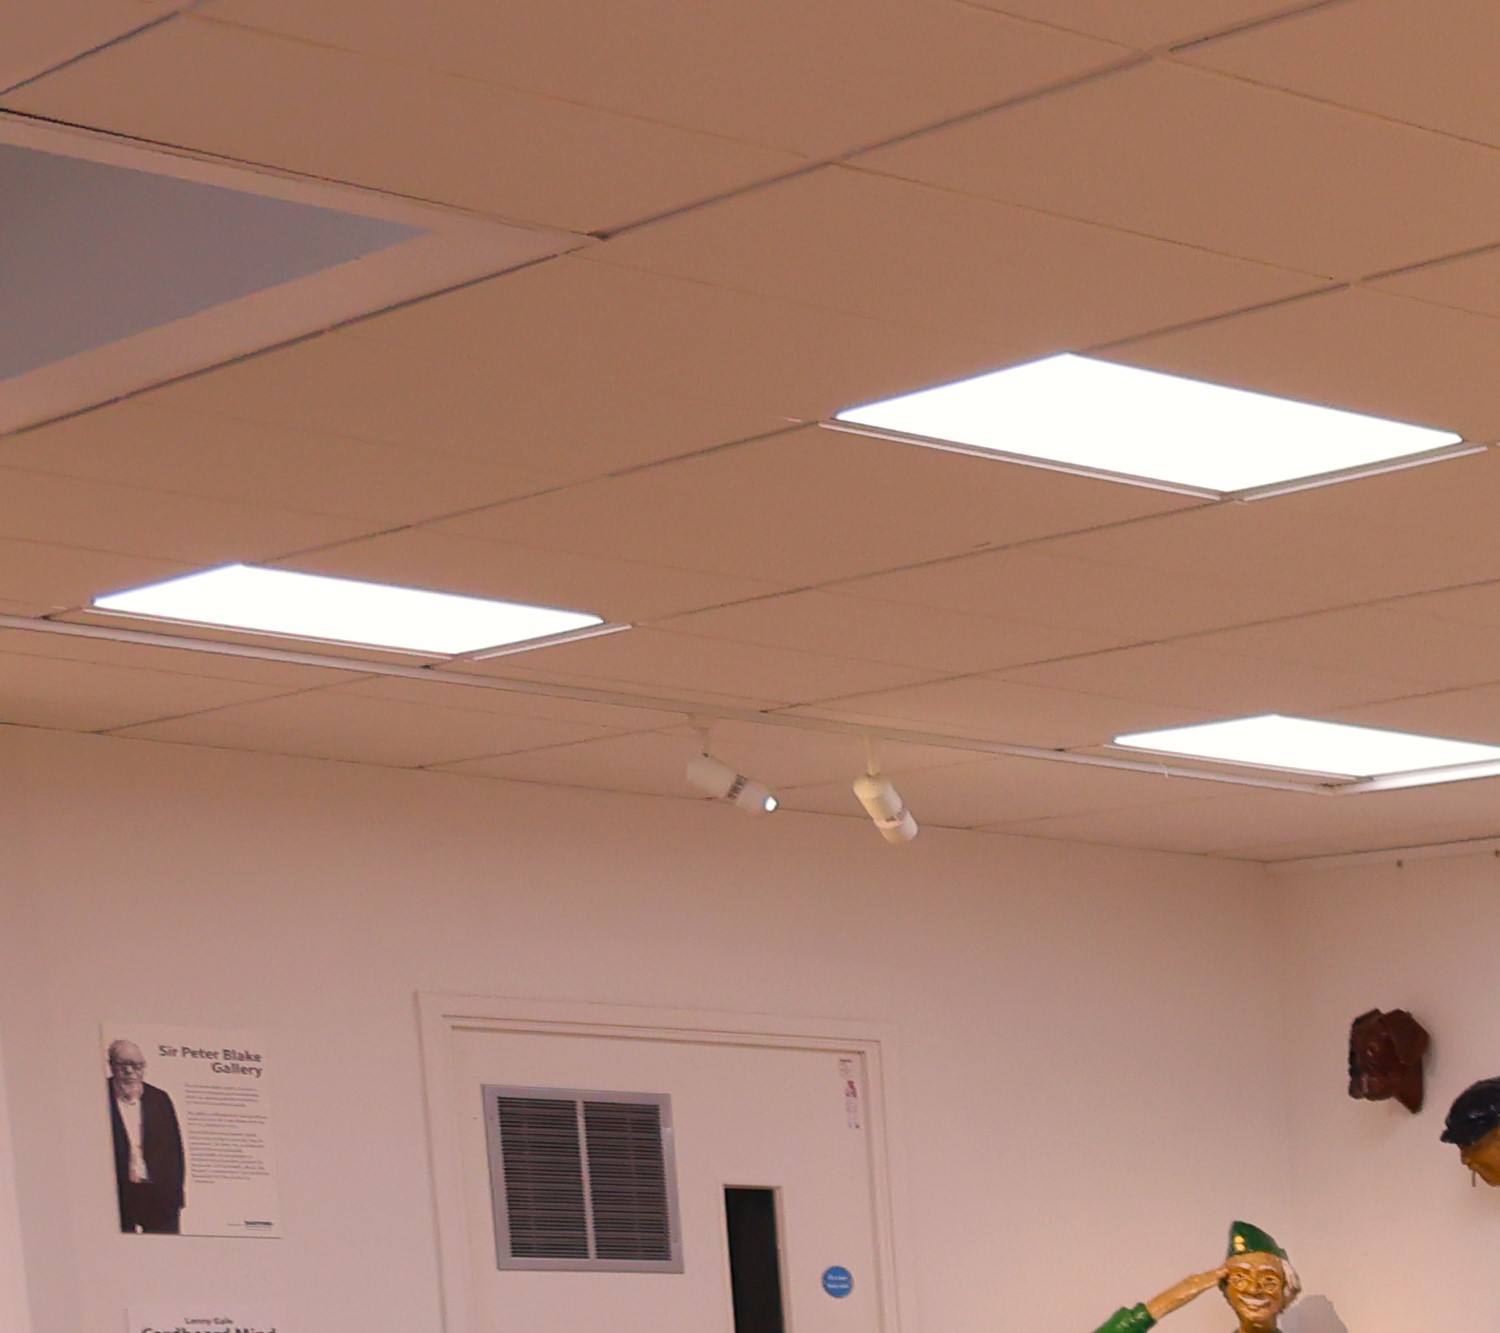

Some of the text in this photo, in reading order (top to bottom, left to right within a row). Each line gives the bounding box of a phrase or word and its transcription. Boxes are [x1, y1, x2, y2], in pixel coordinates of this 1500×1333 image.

[158, 1045, 263, 1063] Sir Peter Blake
[211, 1062, 263, 1078] Gallery
